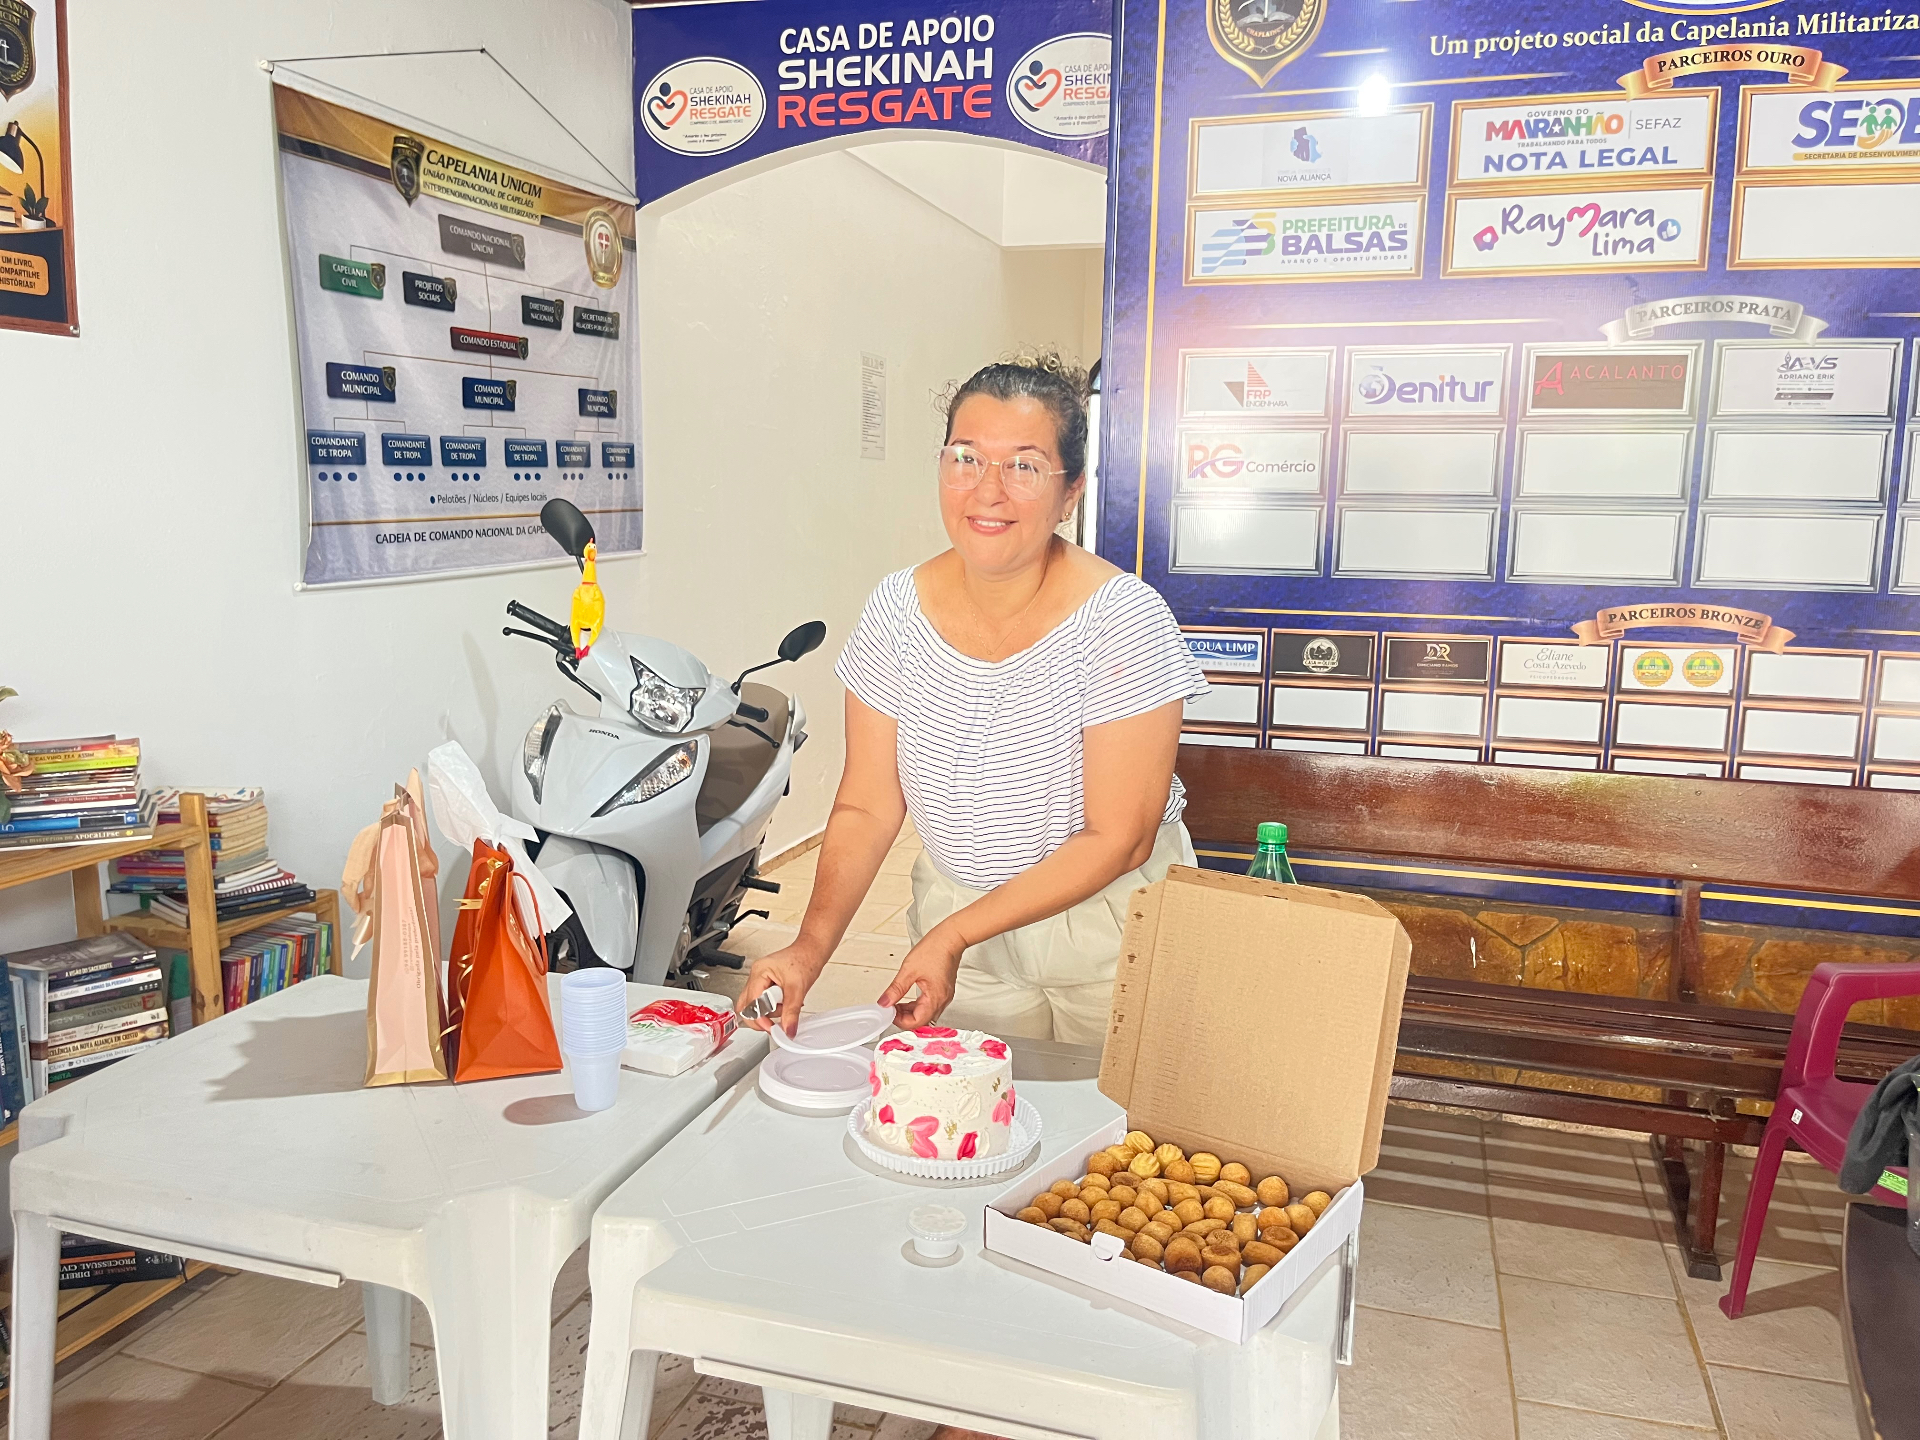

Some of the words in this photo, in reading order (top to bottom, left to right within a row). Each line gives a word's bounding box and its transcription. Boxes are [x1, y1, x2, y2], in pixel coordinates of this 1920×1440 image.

[779, 25, 851, 54] CASA
[858, 22, 894, 49] DE
[901, 14, 995, 47] APOIO
[1430, 35, 1468, 56] Um
[1474, 29, 1558, 59] projeto
[1562, 21, 1630, 47] social
[1636, 20, 1664, 43] da
[1670, 15, 1790, 45] Capelania
[1796, 9, 1920, 35] Militariza
[1657, 50, 1753, 73] PARCEIROS
[1756, 50, 1805, 68] OURO
[777, 47, 993, 91] SHEKINAH
[1065, 65, 1082, 74] CASA
[1083, 64, 1092, 72] DE
[689, 87, 704, 95] CASA
[714, 85, 734, 93] APOIO
[690, 93, 751, 107] SHEKINAH
[777, 83, 992, 129] RESGATE
[690, 105, 752, 120] RESGATE
[1527, 109, 1573, 118] GOVERNO
[1635, 117, 1682, 130] SEFAZ
[1517, 140, 1566, 148] TRABALHANDO
[1586, 137, 1607, 145] TODOS
[1483, 151, 1568, 173] NOTA
[1579, 145, 1678, 168] LEGAL
[1804, 152, 1846, 160] SECRETARIA
[426, 150, 498, 185] CAPELANIA
[500, 173, 542, 199] UNICIM
[1277, 175, 1298, 183] NOVA
[1300, 173, 1331, 182] ALIANÇA
[423, 167, 446, 181] UNIÃO
[446, 175, 495, 198] INTERNACIONAL
[497, 192, 506, 200] DE
[423, 181, 498, 210] INTERDENOMINACIONAIS
[499, 204, 540, 221] MILITARIZADOS
[1282, 215, 1395, 234] PREFEITURA
[450, 225, 481, 241] COMANDO
[482, 233, 512, 249] NACIONAL
[1281, 229, 1408, 256] BALSAS
[471, 243, 494, 255] UNICIM
[1, 256, 12, 265] UM
[13, 258, 35, 269] LIVRO,
[1333, 254, 1408, 263] OPORTUNIDADE
[0, 267, 41, 280] OMPARTILHE
[332, 264, 368, 278] CAPELANIA
[341, 277, 358, 288] CIVIL
[415, 280, 443, 293] PROJETOS
[418, 292, 441, 303] SOCIAIS
[1636, 301, 1734, 323] PARCEIROS
[1738, 301, 1792, 322] PRATA
[460, 335, 490, 348] COMANDO
[490, 338, 517, 351] ESTADUAL
[341, 370, 379, 383] COMANDO
[1570, 364, 1684, 380] ACALANTO
[342, 384, 382, 396] MUNICIPAL
[474, 384, 504, 395] COMANDO
[1247, 389, 1272, 400] FRP
[475, 395, 504, 406] MUNICIPAL
[587, 394, 609, 404] COMANDO
[311, 436, 359, 447] COMANDANTE
[388, 440, 426, 449] COMANDANTE
[445, 442, 482, 451] COMANDANTE
[509, 444, 542, 452] COMANDANTE
[318, 449, 328, 457] DE
[329, 449, 352, 458] TROPA
[394, 450, 403, 459] DE
[403, 451, 422, 459] TROPA
[451, 452, 459, 460] DE
[460, 453, 477, 461] TROPA
[1187, 443, 1245, 479] RG
[1246, 460, 1316, 473] Comércio
[437, 493, 467, 504] Pelotões
[473, 493, 499, 504] Núcleos
[505, 493, 530, 504] Equipes
[530, 492, 548, 502] locais
[376, 533, 411, 545] CADEIA
[414, 532, 427, 542] DE
[429, 529, 474, 541] COMANDO
[475, 526, 515, 539] NACIONAL
[516, 526, 527, 536] DA
[1608, 607, 1696, 624] PARCEIROS
[1700, 609, 1764, 630] BRONZE
[1226, 640, 1256, 654] LIMP
[1536, 647, 1574, 661] Eliane
[1523, 658, 1550, 669] Costa
[1552, 661, 1587, 670] Azevedo
[588, 728, 620, 740] HONDA
[81, 1257, 137, 1270] PROCESSUAL
